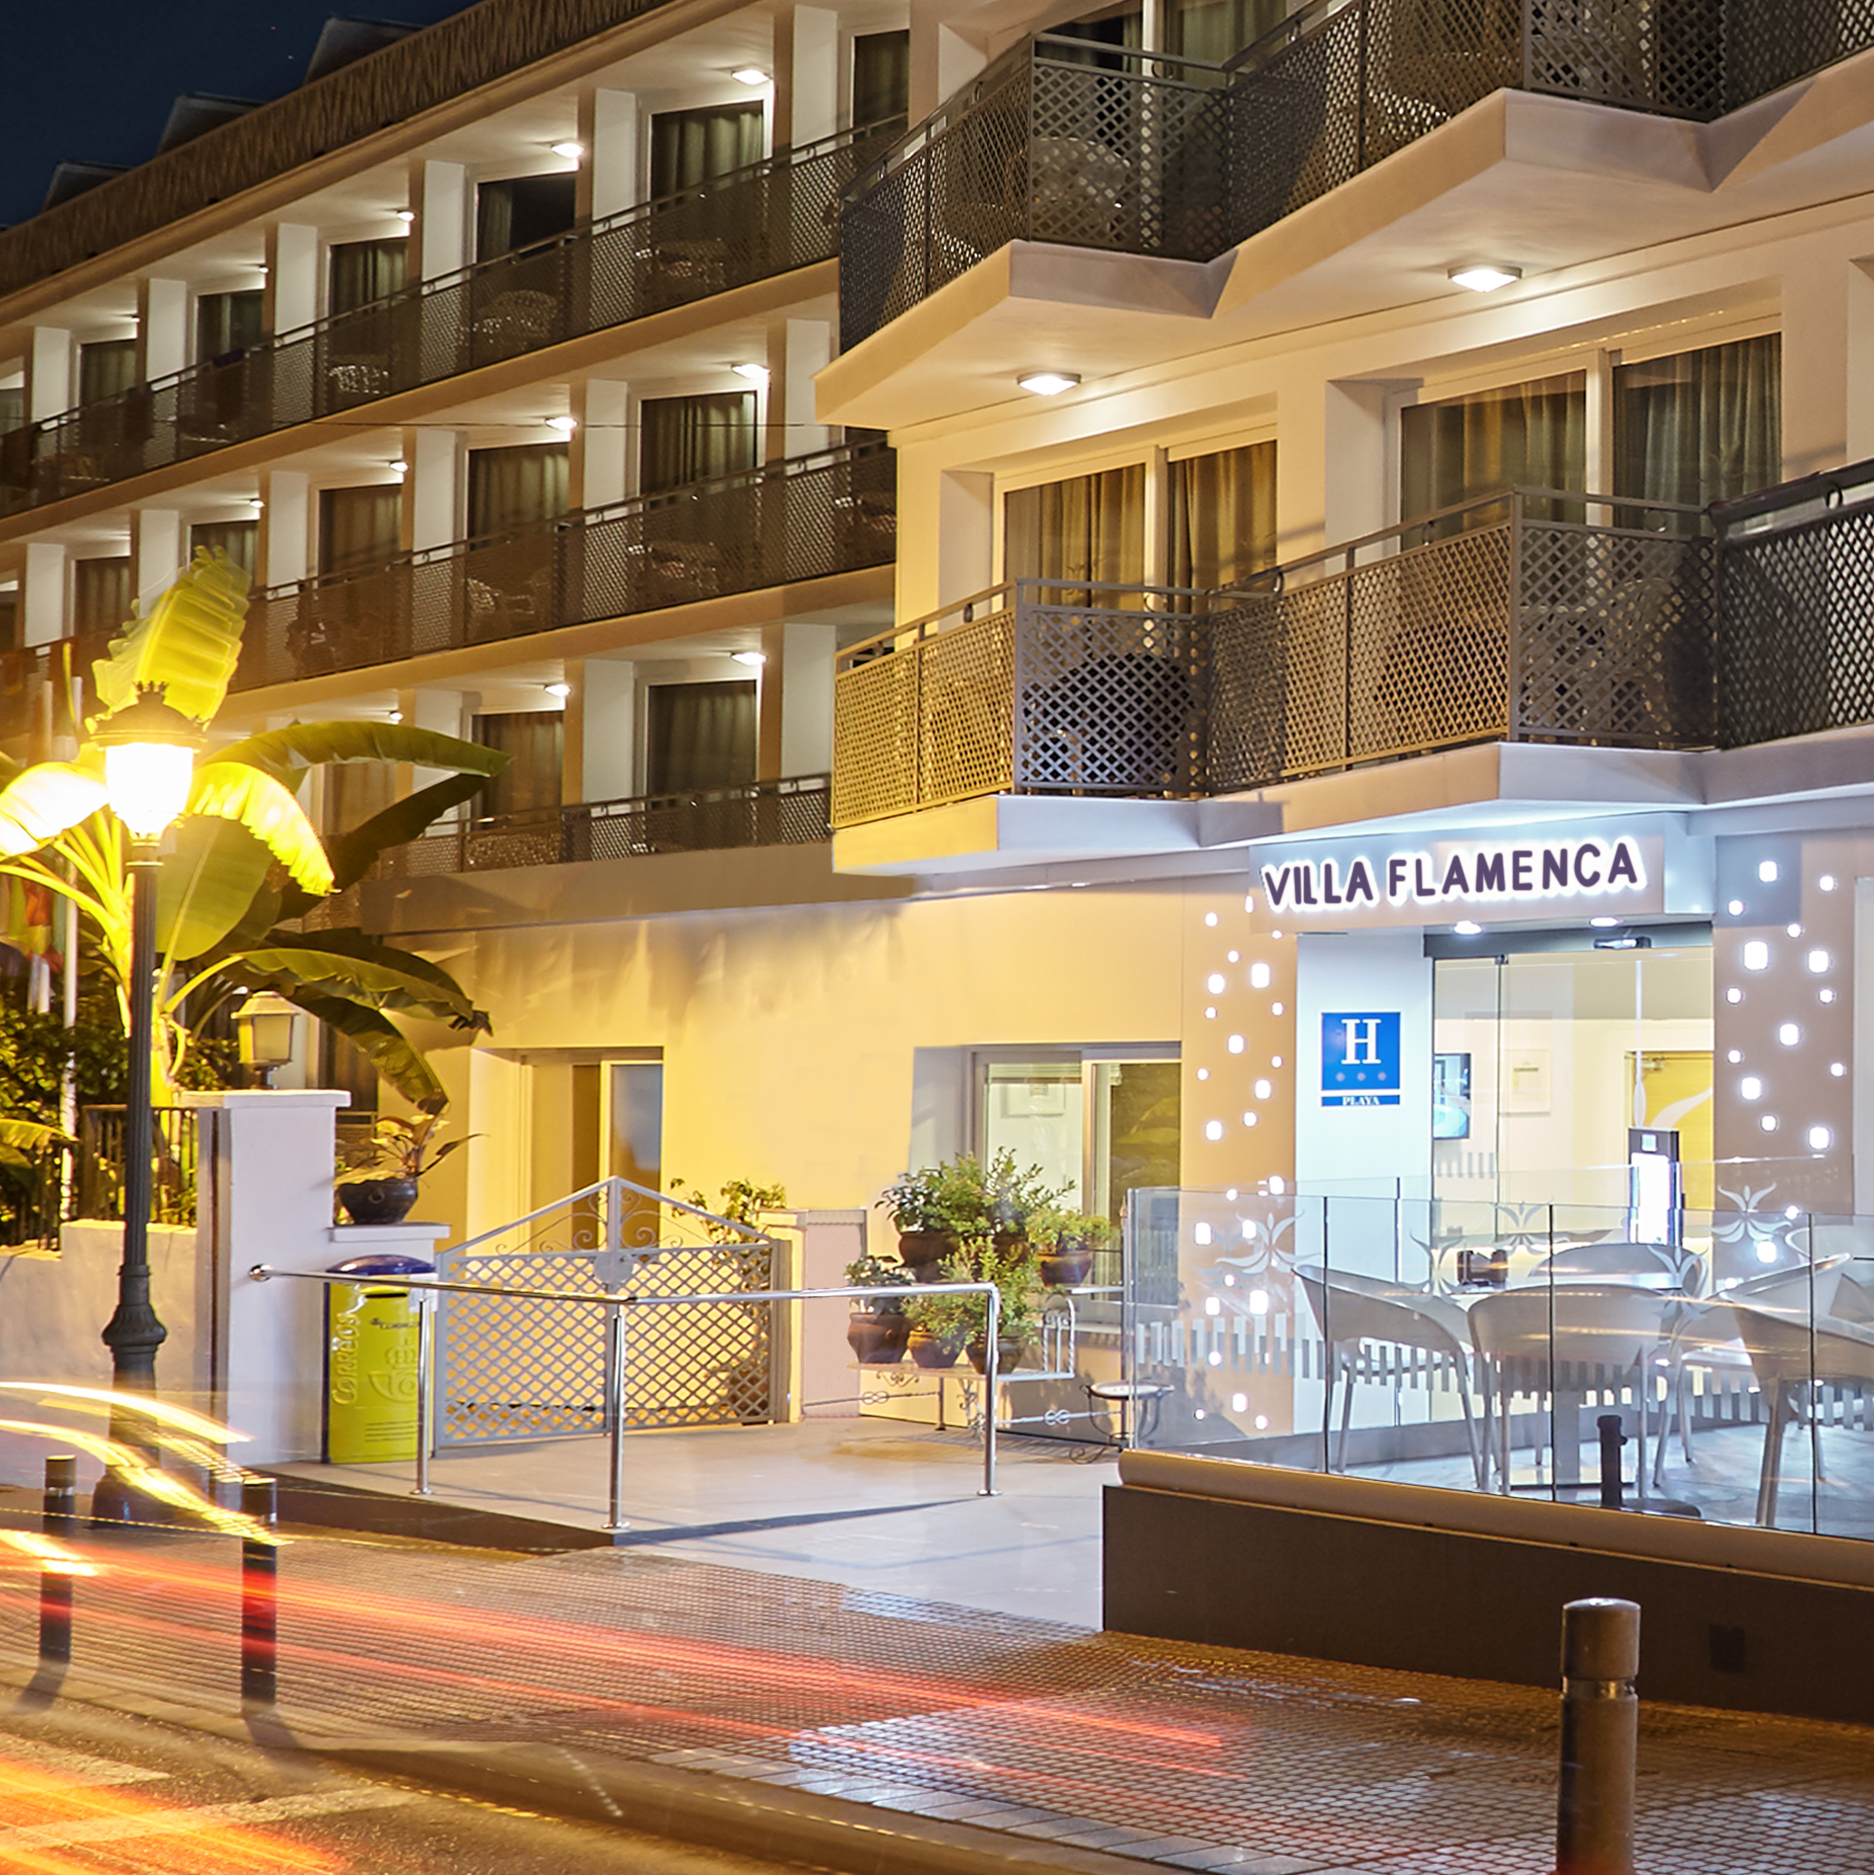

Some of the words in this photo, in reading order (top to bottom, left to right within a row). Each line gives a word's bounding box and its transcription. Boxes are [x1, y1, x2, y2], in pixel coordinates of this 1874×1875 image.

[1263, 860, 1375, 906] VILLA
[1388, 842, 1638, 898] FLAMENCA
[1341, 1018, 1382, 1065] H
[1342, 1095, 1381, 1106] PLAYA
